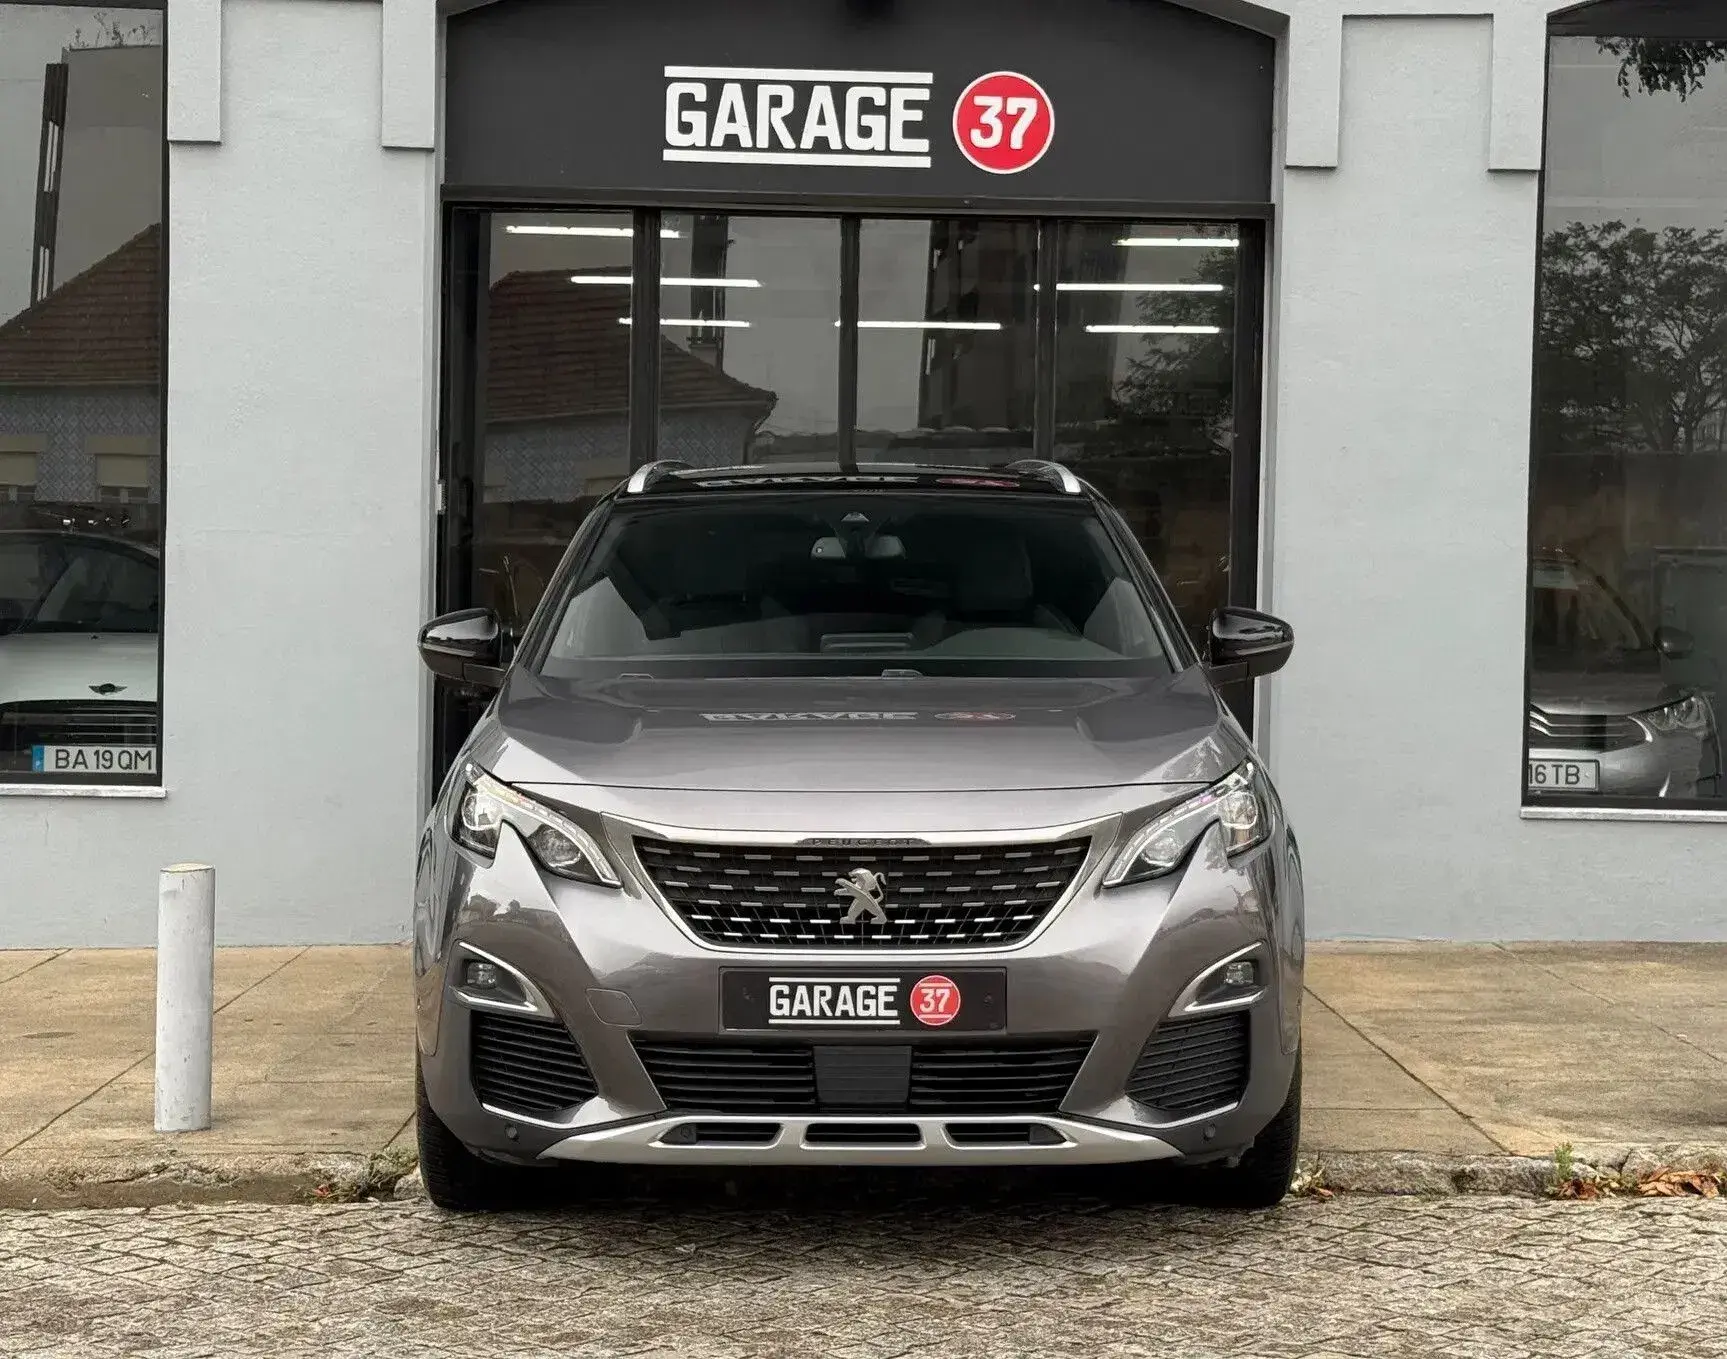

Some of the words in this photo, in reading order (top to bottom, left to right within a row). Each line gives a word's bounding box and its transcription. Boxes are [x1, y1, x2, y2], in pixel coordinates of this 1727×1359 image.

[665, 81, 930, 153] GARAGE
[969, 95, 1038, 150] 37
[55, 749, 89, 769] BA
[93, 750, 114, 770] 19
[117, 750, 152, 771] QM
[1551, 764, 1580, 785] TB
[769, 984, 898, 1017] GARAGE
[919, 988, 951, 1013] 37
